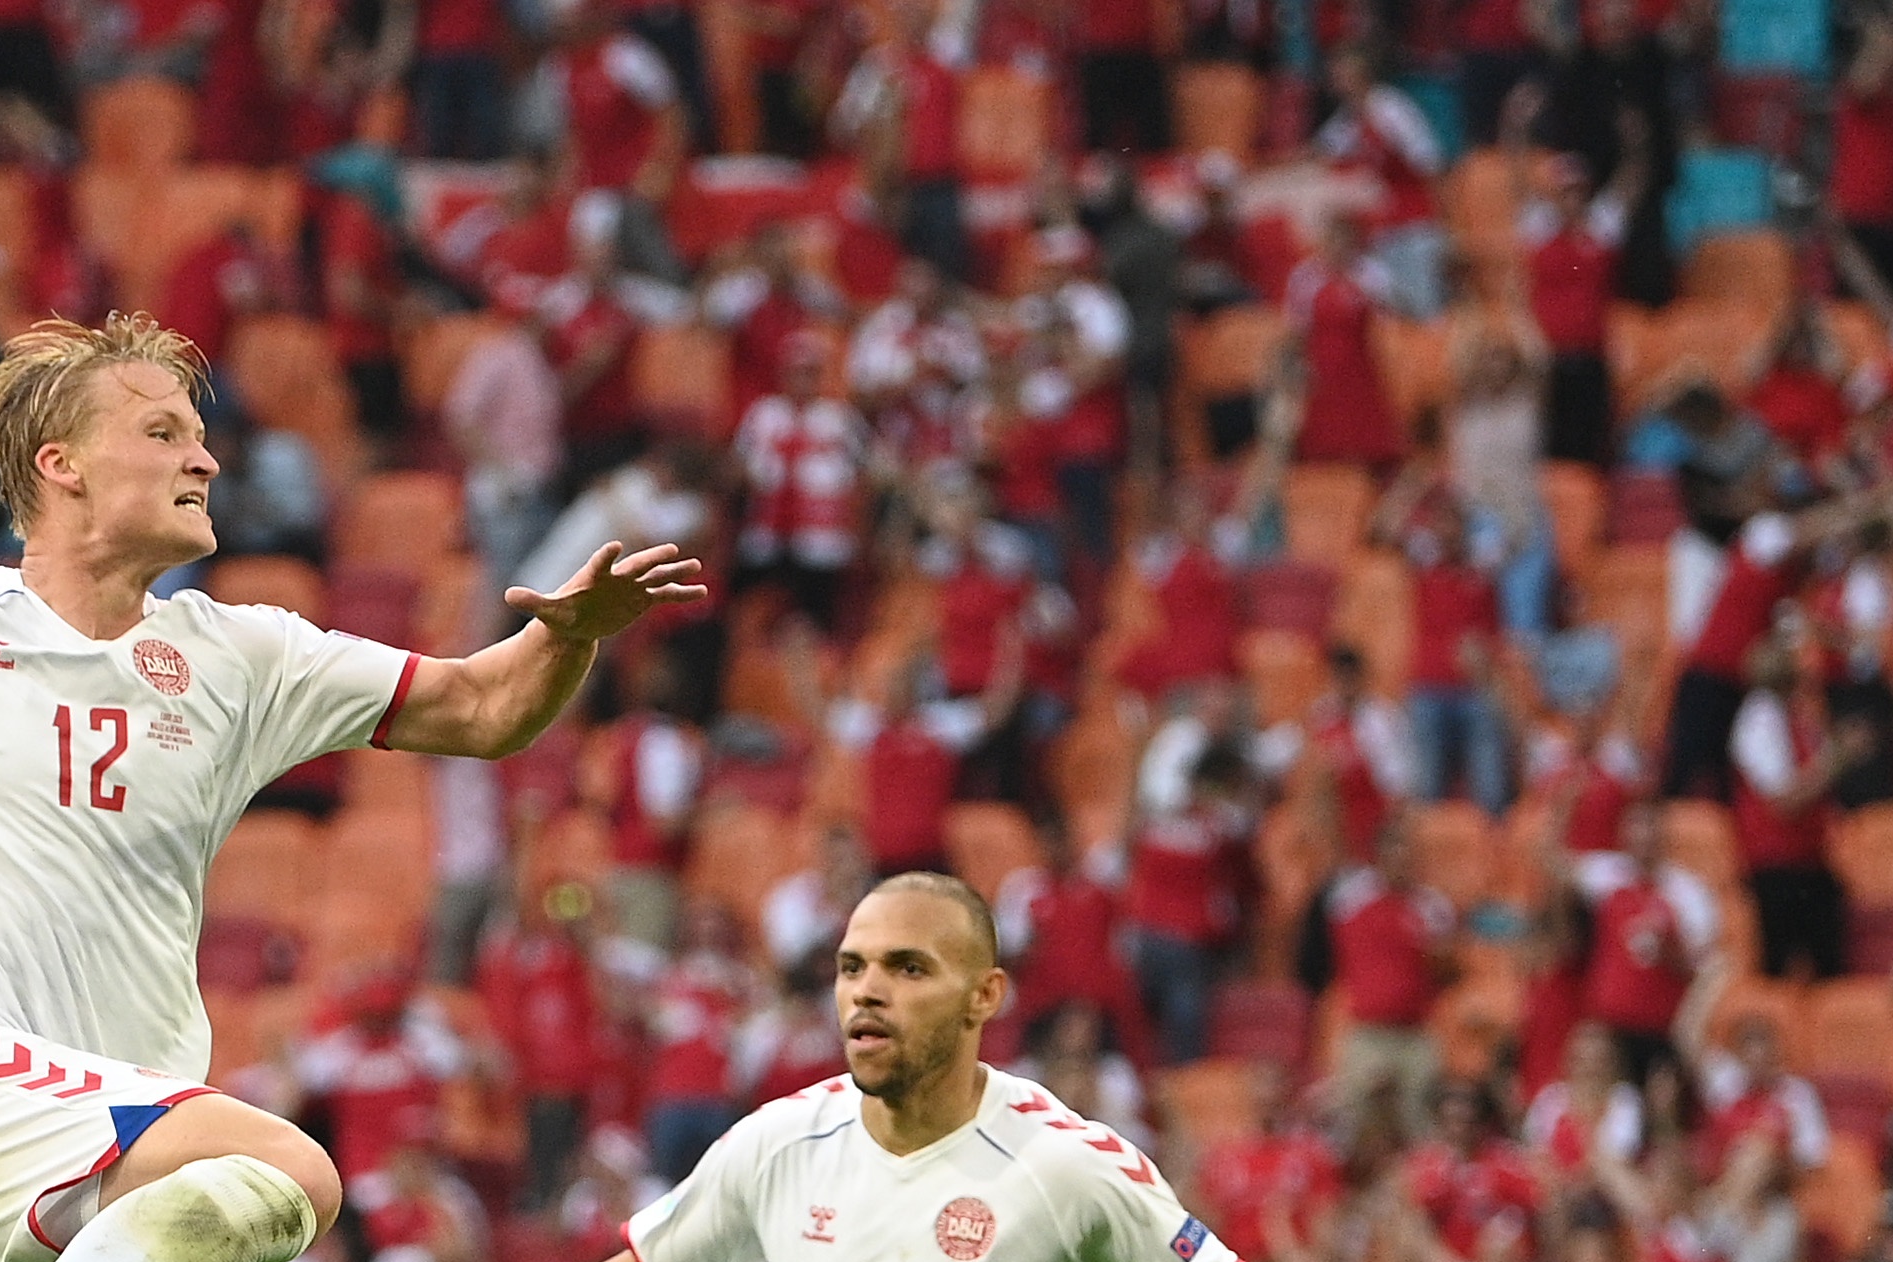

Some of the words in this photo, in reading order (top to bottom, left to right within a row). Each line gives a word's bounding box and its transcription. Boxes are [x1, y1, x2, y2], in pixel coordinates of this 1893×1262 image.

[142, 655, 180, 677] DBU
[53, 705, 128, 812] 12
[947, 1216, 985, 1241] DBU
